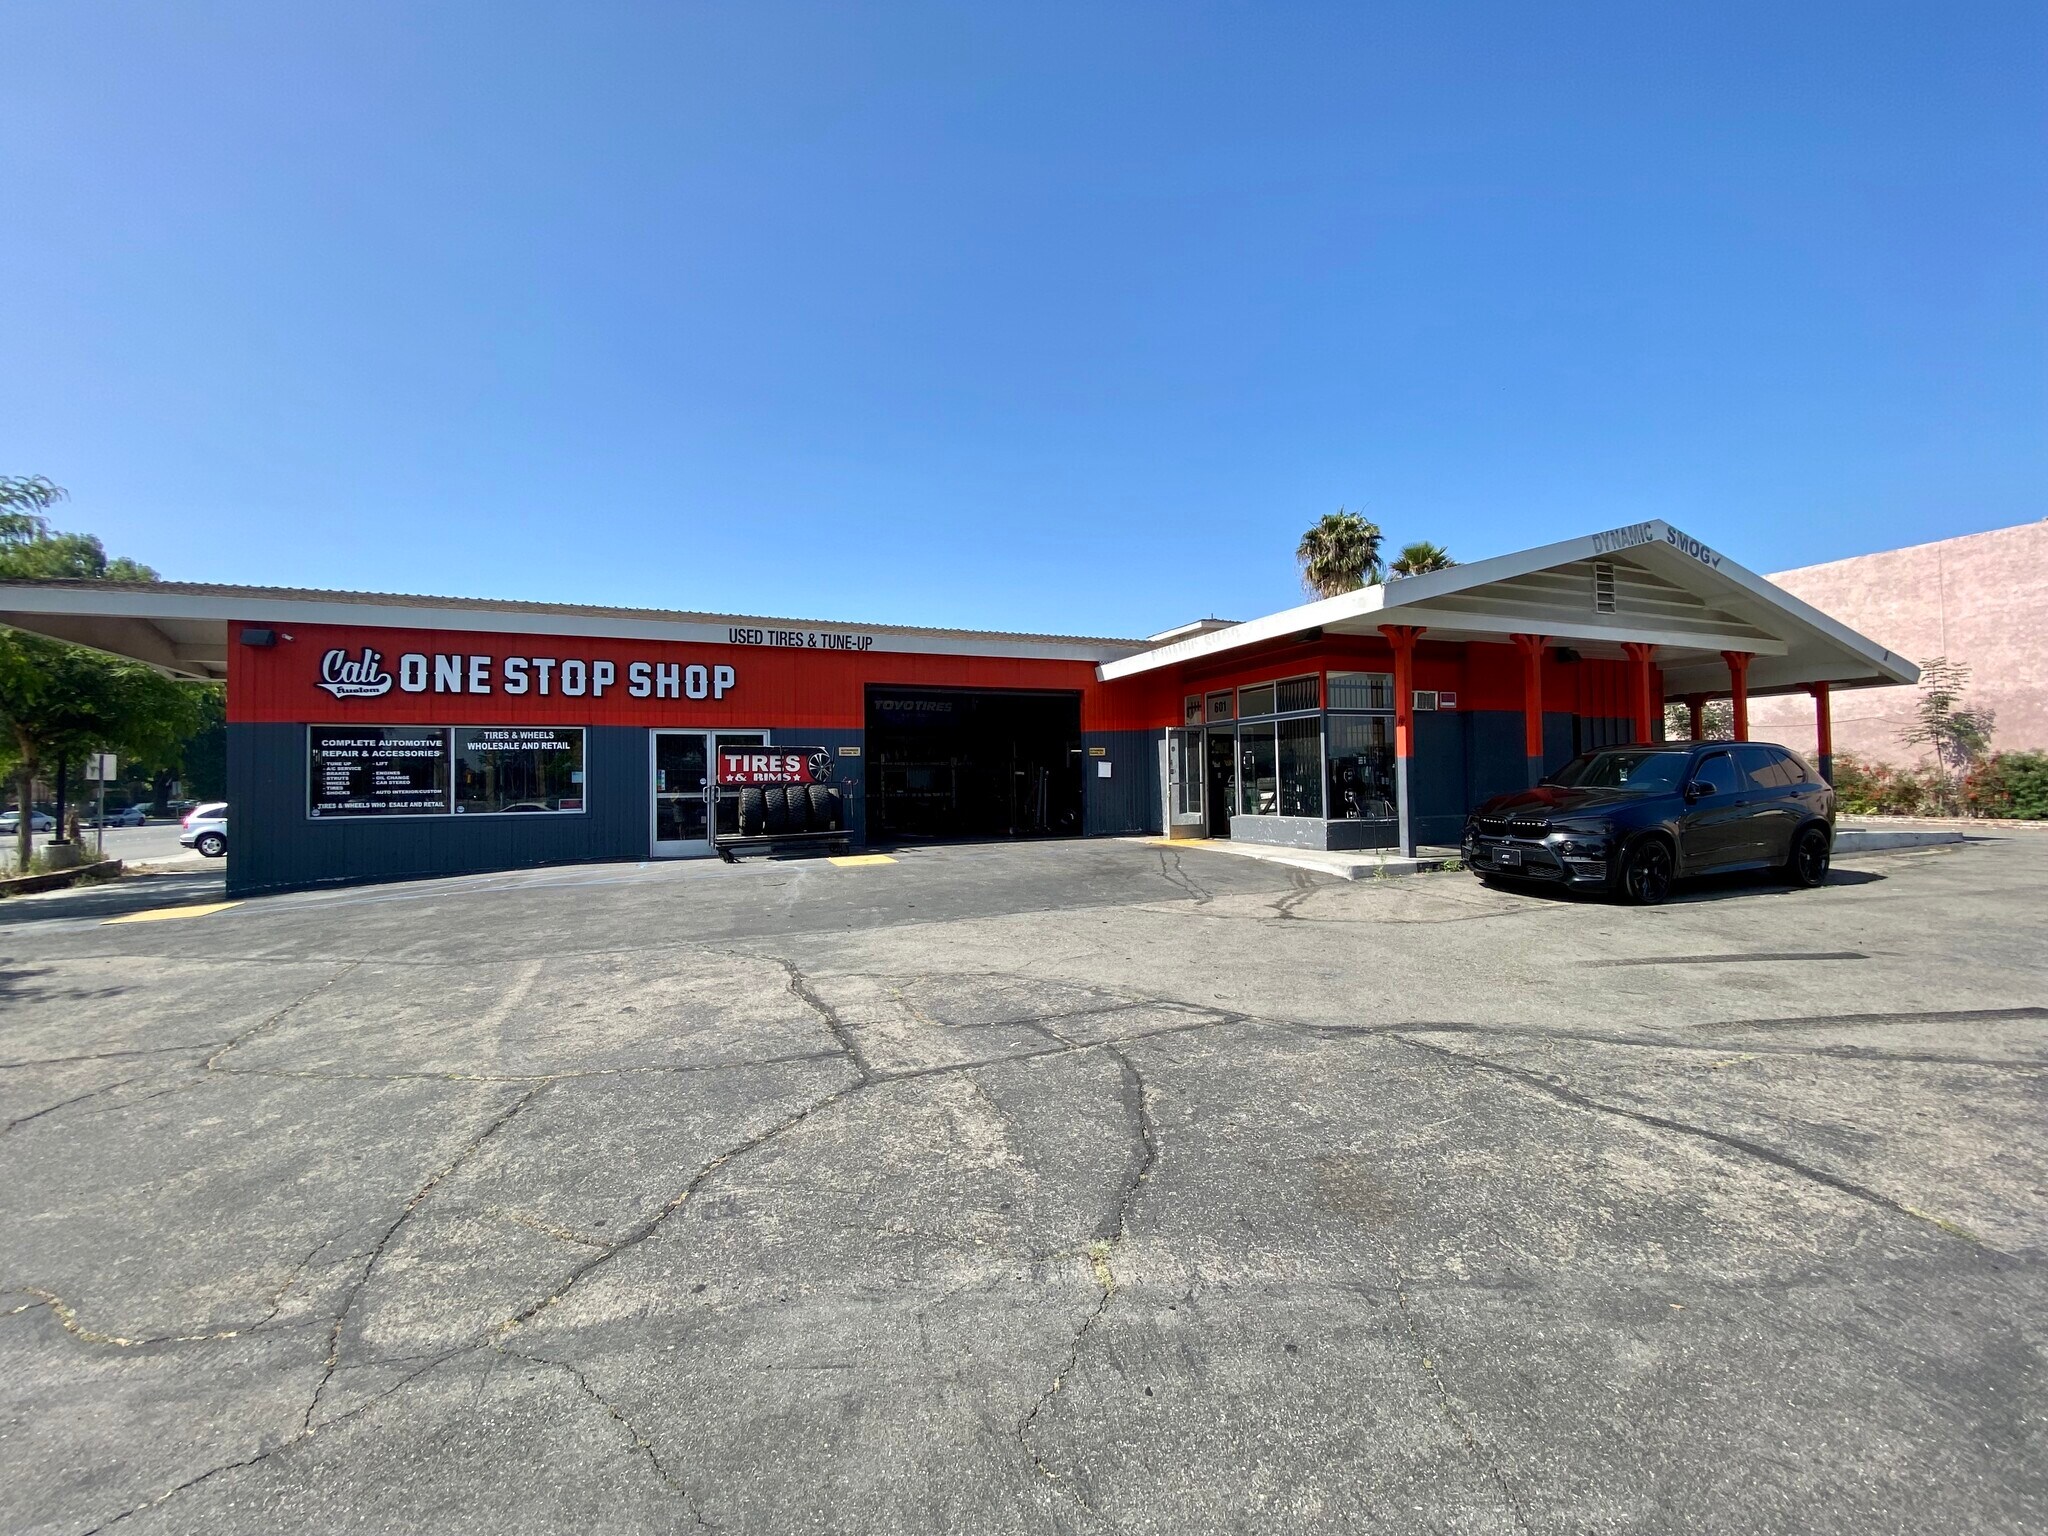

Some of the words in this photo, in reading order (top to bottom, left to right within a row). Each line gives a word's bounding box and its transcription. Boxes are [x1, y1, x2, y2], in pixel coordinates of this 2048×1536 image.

[1592, 522, 1653, 554] DYNAMIC
[1667, 526, 1711, 564] SMOG
[729, 628, 763, 645] USED
[767, 630, 804, 647] TIRES
[807, 633, 817, 648] &
[821, 634, 873, 651] TUNE-UP
[322, 648, 382, 683] Cali
[400, 653, 492, 694] ONE
[504, 657, 615, 697] STOP
[629, 661, 735, 699] SHOP
[874, 700, 914, 711] TOYO
[915, 700, 953, 712] TIRES
[1214, 701, 1227, 713] 601
[484, 731, 509, 739] TIRES
[512, 731, 518, 739] &
[520, 731, 554, 739] WHEELS
[467, 742, 519, 750] WHOLESALE
[521, 742, 539, 750] AND
[541, 742, 571, 750] RETAIL
[724, 754, 801, 772] TIRES
[735, 773, 747, 782] &
[753, 773, 791, 782] RIMS
